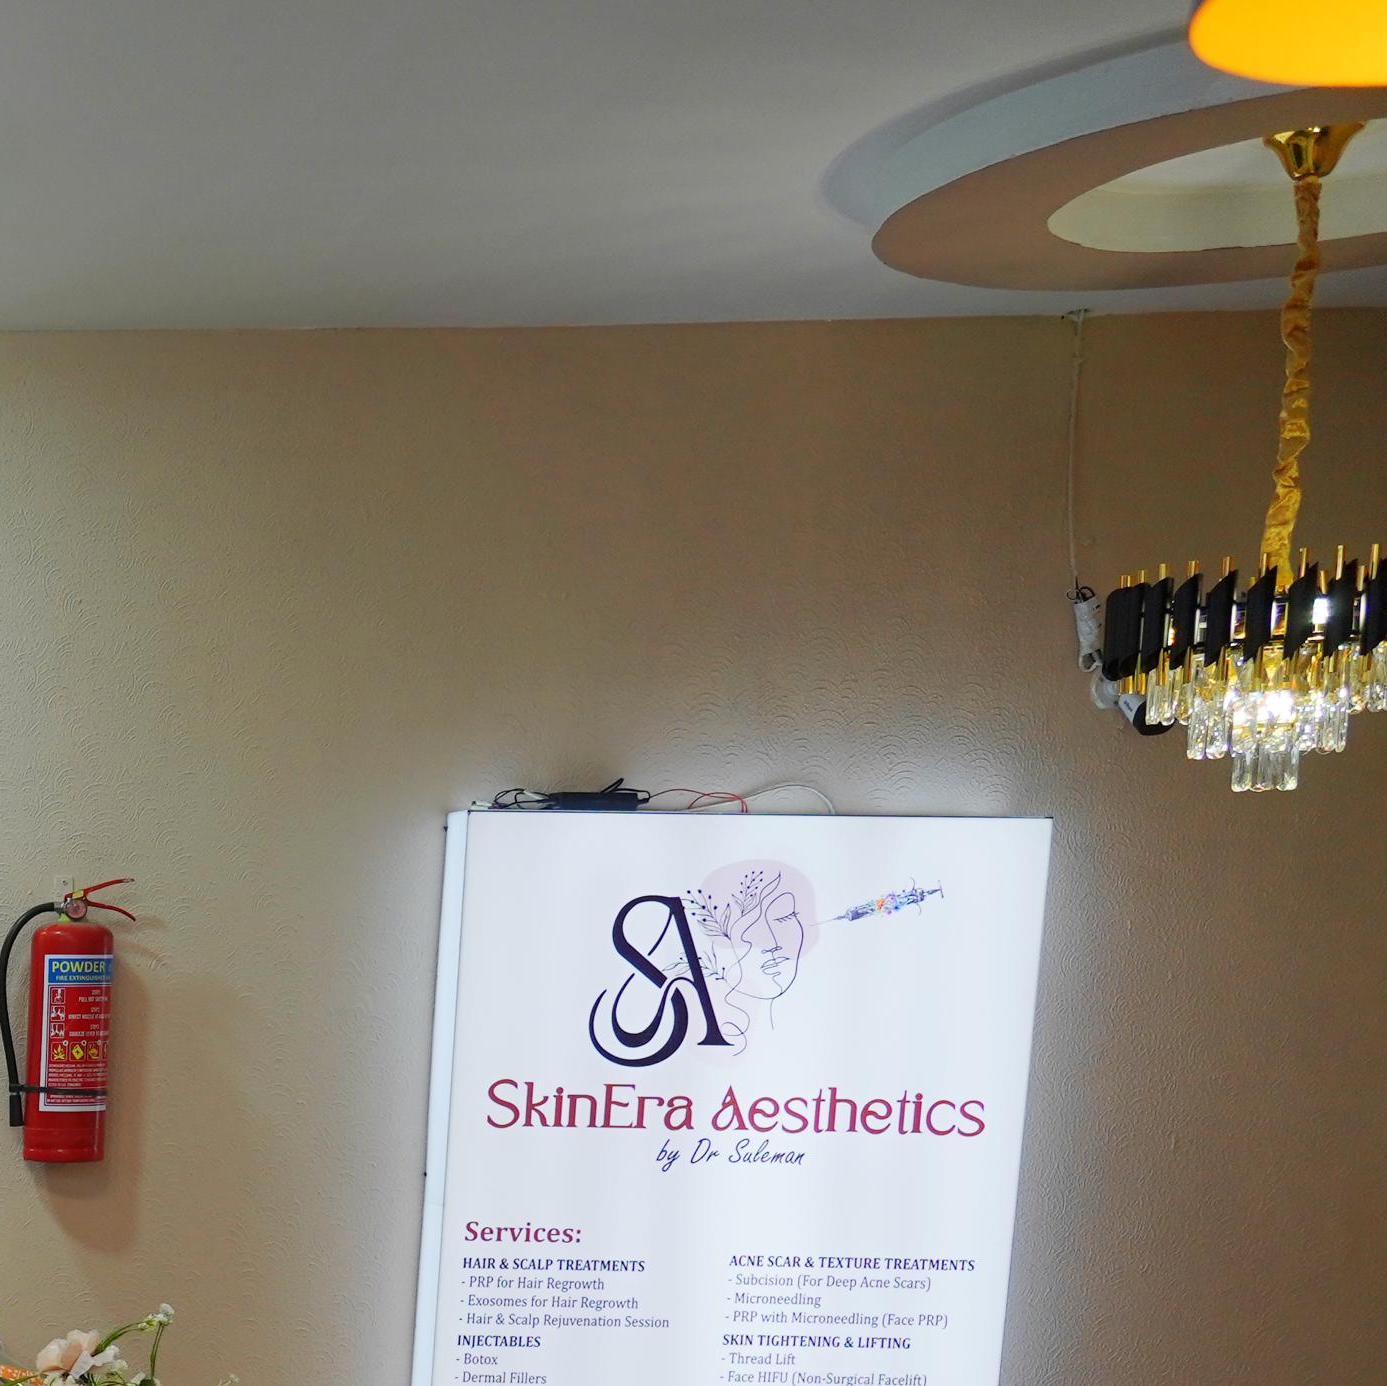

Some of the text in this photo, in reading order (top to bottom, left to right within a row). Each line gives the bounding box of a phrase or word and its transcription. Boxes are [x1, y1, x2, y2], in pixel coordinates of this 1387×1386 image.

[52, 961, 105, 973] POWDER
[486, 1078, 986, 1137] SkinEra Aesthetics
[655, 1137, 805, 1172] by Dr Suleman
[464, 1221, 581, 1243] Services:
[463, 1257, 645, 1272] HAIR & SCALP TREATMENTS
[729, 1255, 975, 1271] ACNE SCAR & TEXTURE TREATMENTS
[469, 1275, 604, 1293] PRP for Hair Regrowth
[734, 1292, 822, 1309] Microneedling
[457, 1334, 541, 1348] INJECTABLES
[722, 1334, 910, 1349] SKIN TIGHTENING & LIFTING
[463, 1352, 498, 1365] Botox
[728, 1351, 796, 1365] Thread Lift
